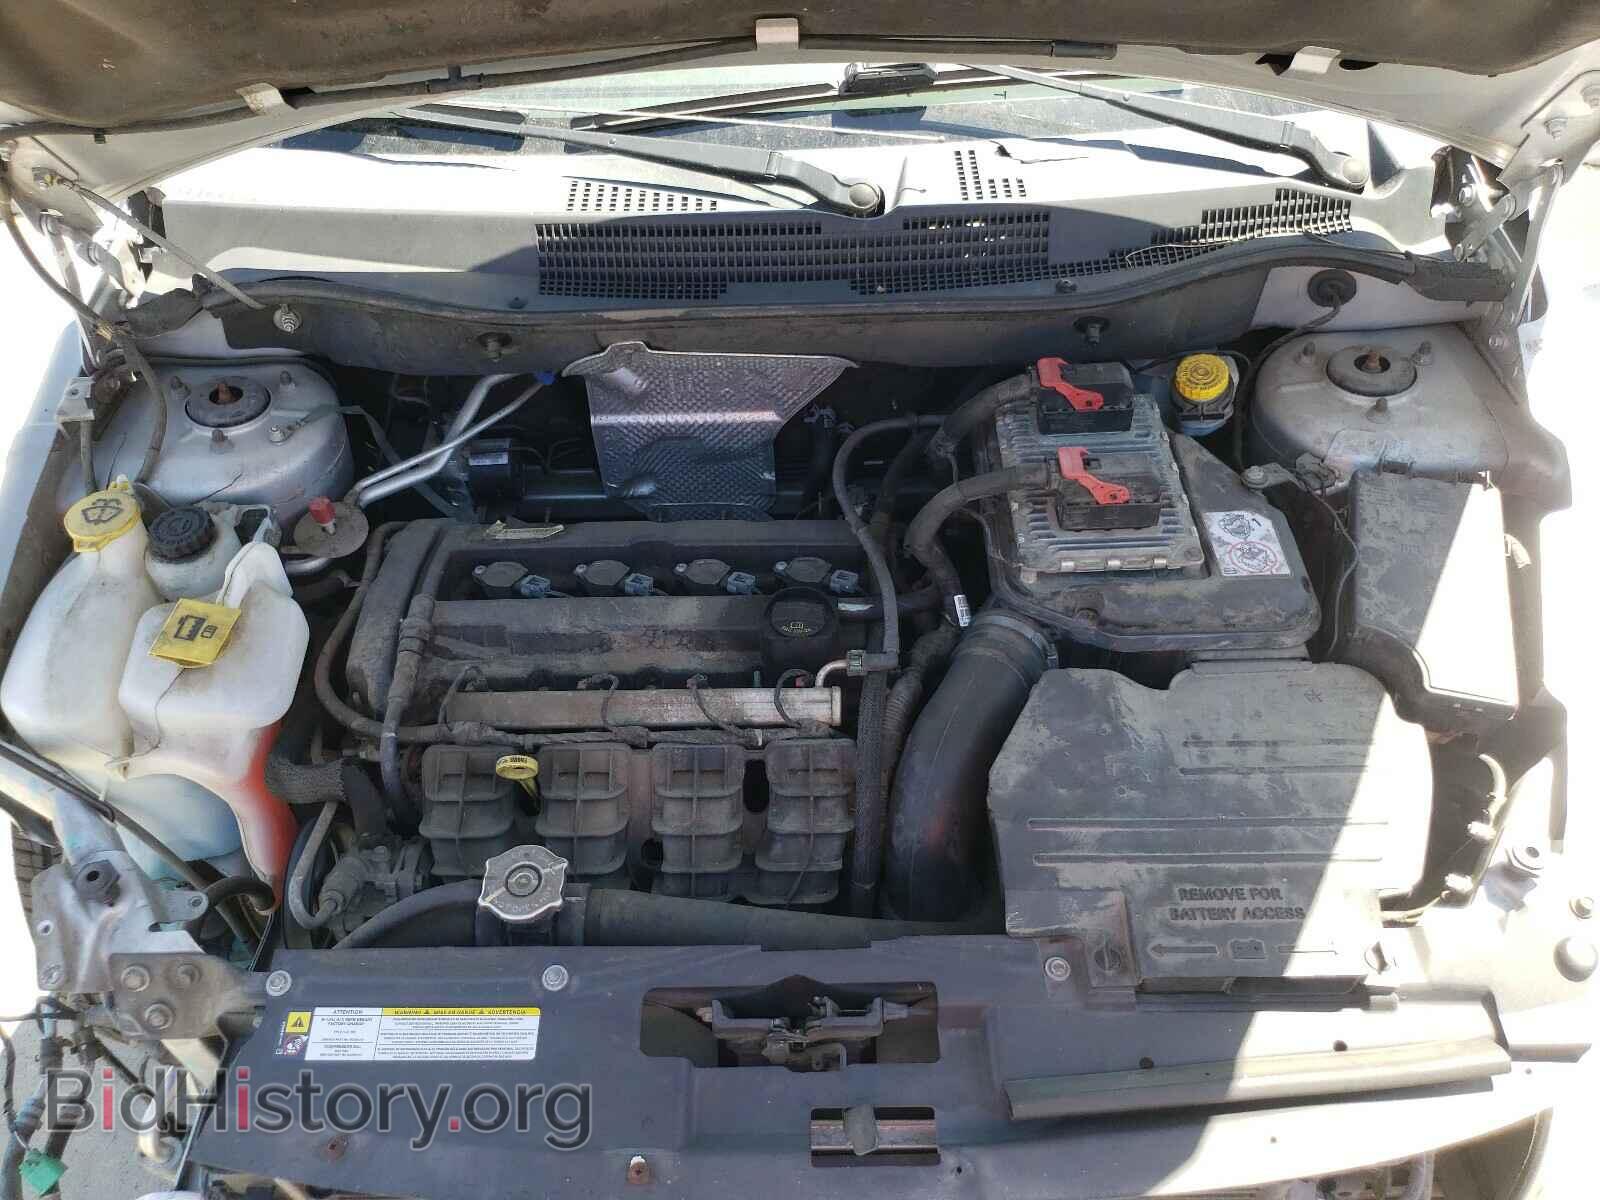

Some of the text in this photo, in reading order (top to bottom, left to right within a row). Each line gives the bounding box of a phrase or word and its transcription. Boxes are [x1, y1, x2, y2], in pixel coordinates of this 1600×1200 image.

[1177, 887, 1283, 901] REMOVE FOR
[1168, 906, 1306, 921] BATTERY ACCESS
